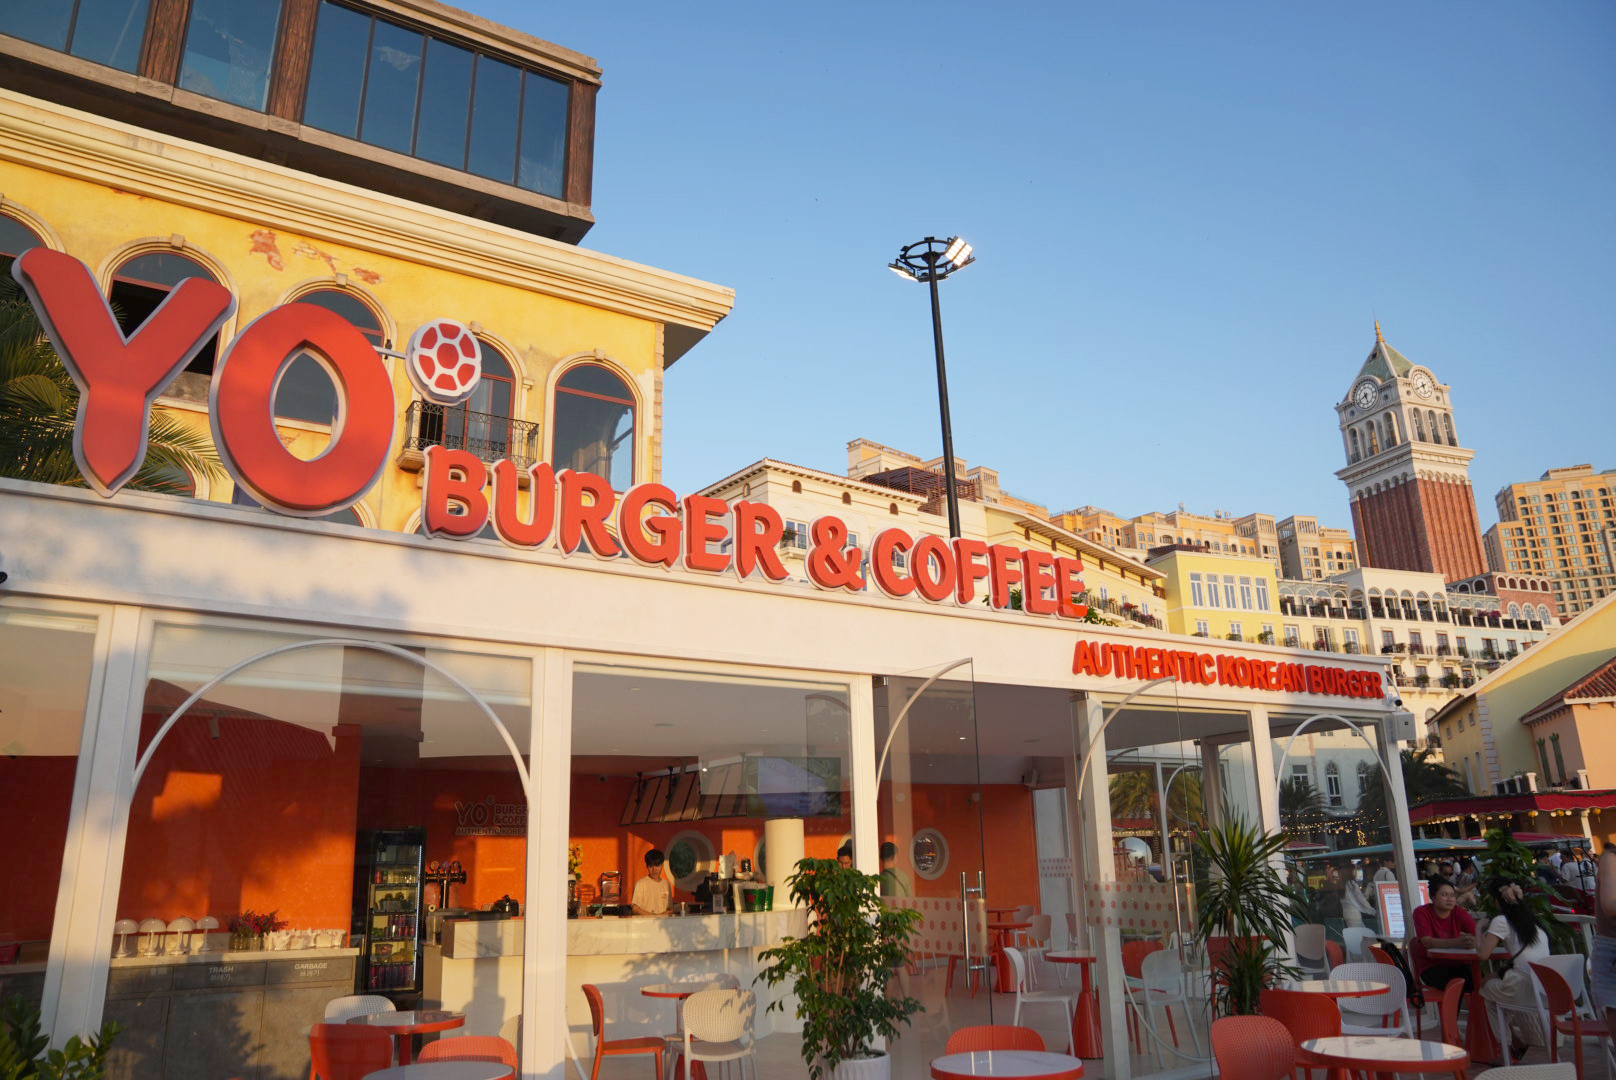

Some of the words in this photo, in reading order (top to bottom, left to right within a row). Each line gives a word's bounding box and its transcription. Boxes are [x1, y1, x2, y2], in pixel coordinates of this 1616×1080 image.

[12, 246, 396, 517] YO
[421, 444, 790, 584] BURGER
[805, 515, 867, 594] &
[870, 527, 1089, 621] COFFEE
[1072, 639, 1217, 685] AUTHENTIC
[1216, 653, 1307, 693] KOREAN
[1305, 664, 1386, 699] BURGER
[495, 804, 528, 815] BURGE
[209, 966, 234, 974] TRASH
[294, 962, 328, 970] GARBAGE
